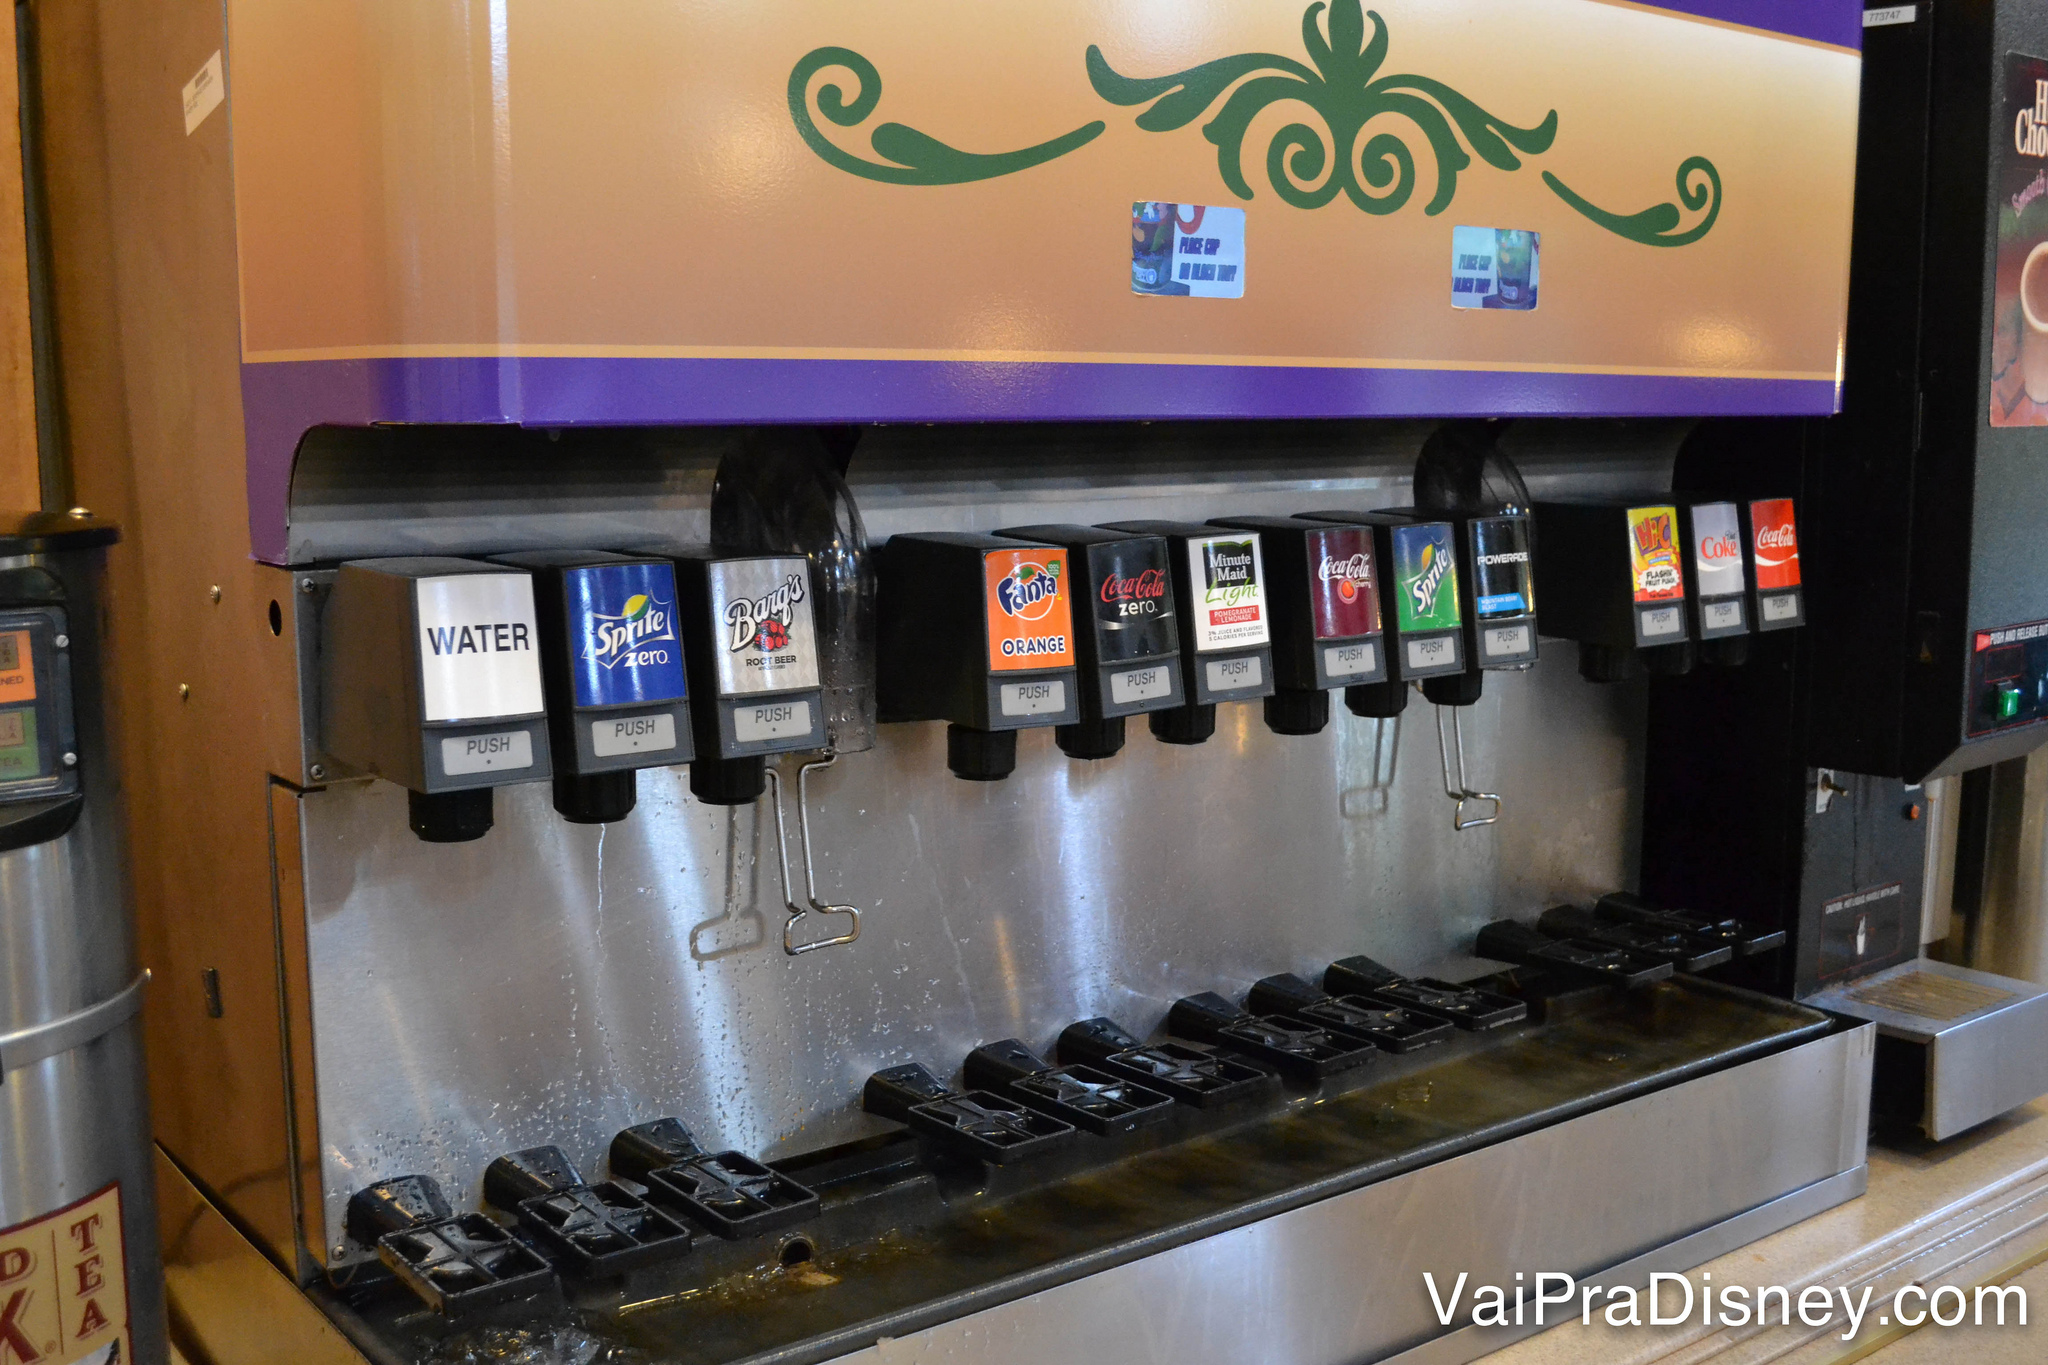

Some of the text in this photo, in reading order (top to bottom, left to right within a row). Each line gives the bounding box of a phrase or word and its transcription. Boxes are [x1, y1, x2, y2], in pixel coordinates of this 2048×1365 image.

[1869, 10, 1901, 22] 773747
[2015, 108, 2048, 158] Cho
[1757, 524, 1794, 549] Coca-Cola
[1701, 537, 1737, 559] Coke
[1209, 553, 1251, 568] Minute
[1318, 553, 1370, 581] Coca-Cola
[1477, 552, 1528, 566] POWERADE
[1217, 566, 1247, 581] Maid
[1412, 547, 1448, 614] Sprite
[1100, 569, 1166, 602] Coca-Cola
[1205, 577, 1259, 606] Light
[997, 573, 1058, 617] Fanta
[1772, 598, 1788, 608] PUSH
[723, 574, 804, 653] Barq's
[1119, 600, 1156, 616] zero
[1214, 607, 1256, 618] POMEGRANATE
[1715, 604, 1732, 616] PUSH
[1221, 614, 1252, 623] LEMONADE
[1652, 612, 1670, 622] PUSH
[427, 622, 530, 656] WATER
[594, 609, 667, 657] Sprite
[1497, 628, 1519, 641] PUSH
[1001, 636, 1066, 656] ORANGE
[1420, 641, 1444, 653] PUSH
[624, 649, 668, 668] zero
[746, 655, 797, 667] ROOT BEER
[1338, 648, 1363, 662] PUSH
[1221, 662, 1248, 676] PUSH
[1127, 671, 1156, 687] PUSH
[1018, 685, 1050, 700] PUSH
[755, 706, 793, 724] PUSH
[614, 720, 656, 738] PUSH
[466, 737, 510, 756] PUSH
[71, 1213, 110, 1339] TEA
